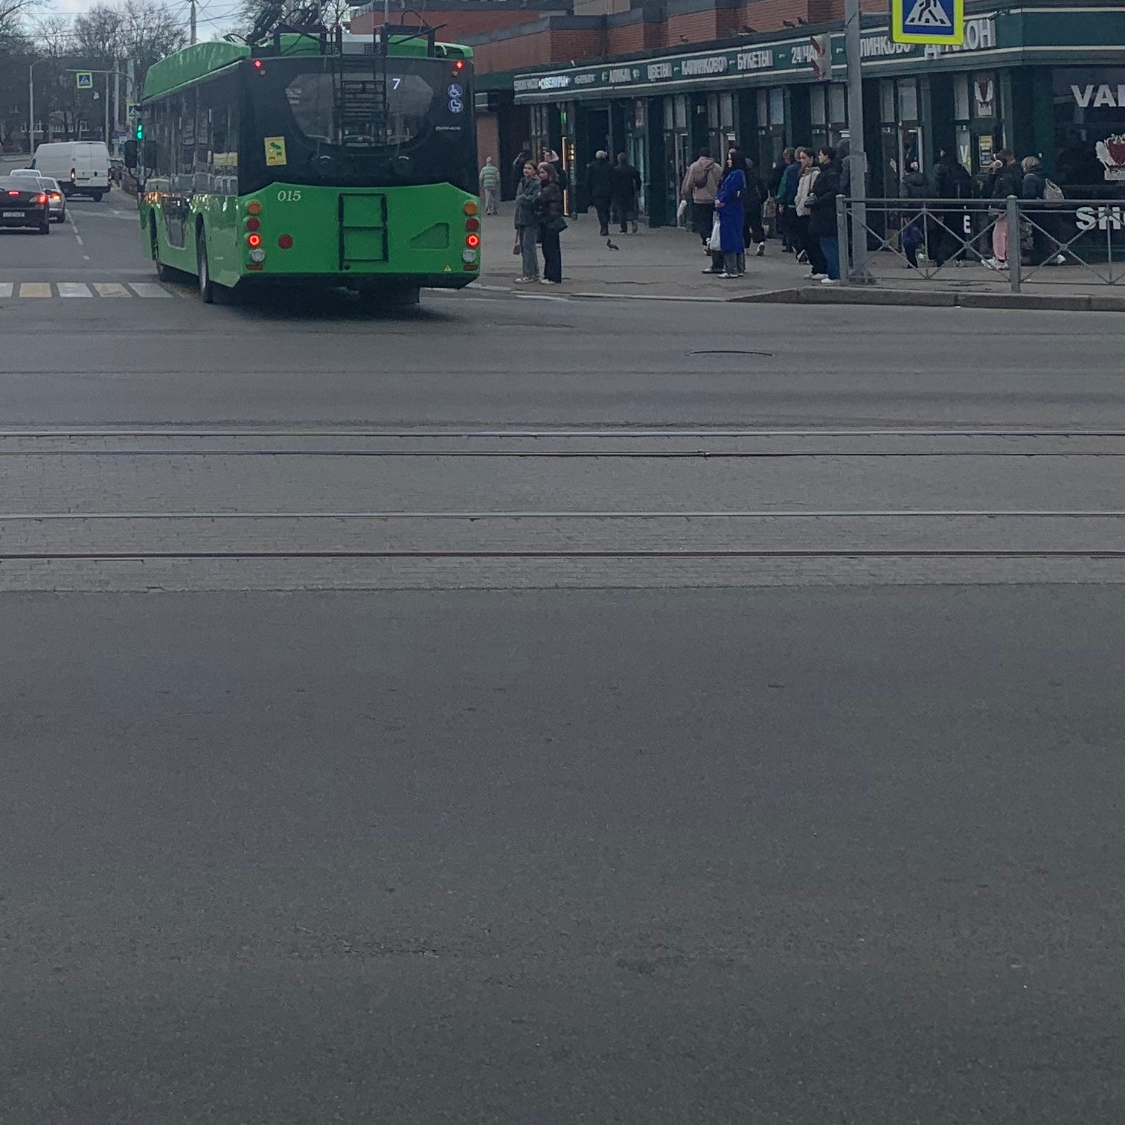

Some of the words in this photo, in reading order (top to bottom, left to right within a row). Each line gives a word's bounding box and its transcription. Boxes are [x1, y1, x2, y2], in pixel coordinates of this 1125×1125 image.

[737, 50, 773, 70] БУКЕТЫ
[859, 36, 911, 57] ЛИНКОВО
[392, 78, 401, 90] 7
[277, 190, 301, 203] 015
[1075, 206, 1125, 231] SH
